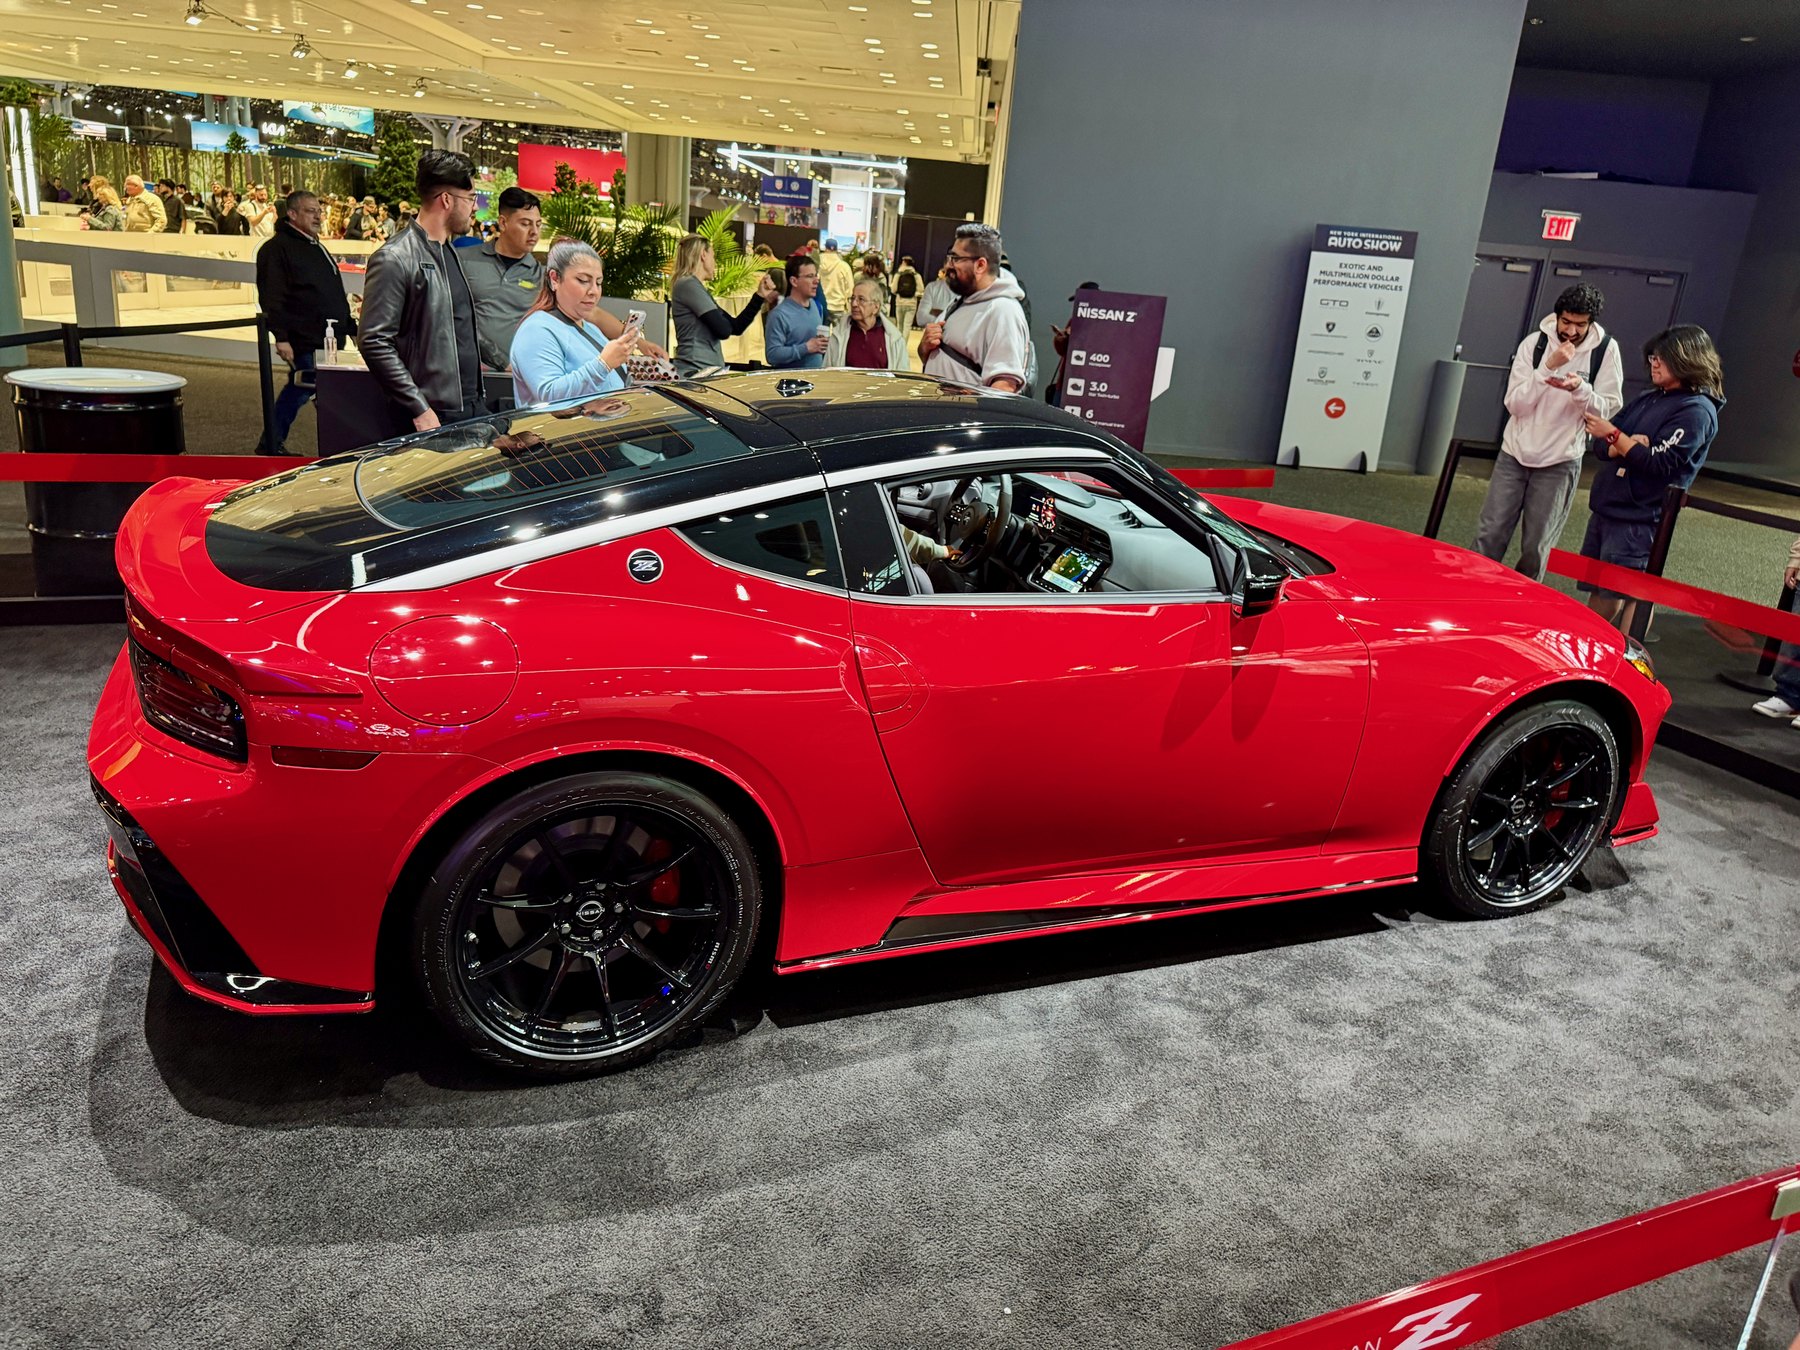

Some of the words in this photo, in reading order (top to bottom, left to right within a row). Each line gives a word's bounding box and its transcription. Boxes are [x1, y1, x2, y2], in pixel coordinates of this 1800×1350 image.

[262, 121, 285, 137] KIA
[1547, 216, 1574, 238] EXIT
[1359, 232, 1402, 241] INTERNATIONAL
[1327, 236, 1362, 249] AUTO
[1363, 239, 1402, 252] SHOW
[1339, 262, 1365, 271] EXOTIC
[1319, 270, 1370, 280] MULTIMILLION
[1313, 278, 1367, 289] PERFORMANCE
[1369, 283, 1403, 292] VEHICLES
[1320, 298, 1349, 307] GTO
[1077, 307, 1124, 321] NISSAN
[1089, 353, 1110, 363] 400
[1089, 381, 1108, 392] 3.0
[1085, 409, 1094, 419] 6
[576, 907, 605, 917] NISSAN
